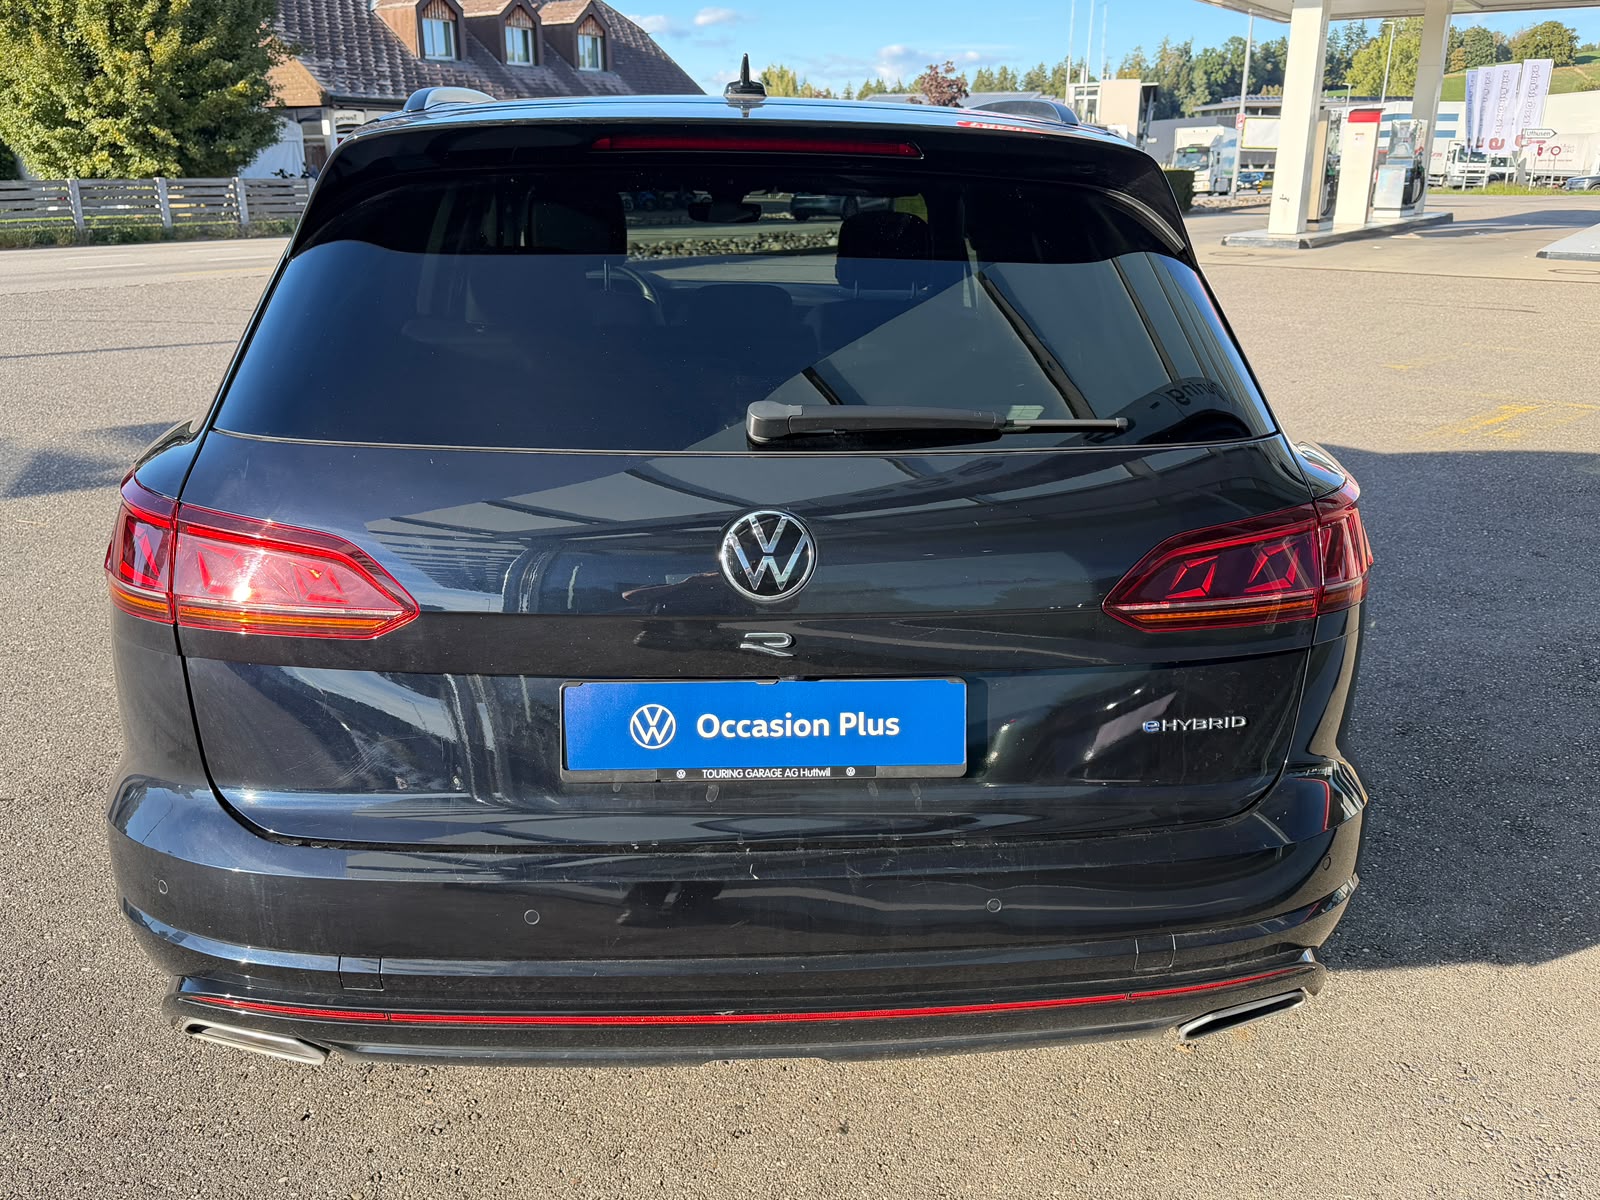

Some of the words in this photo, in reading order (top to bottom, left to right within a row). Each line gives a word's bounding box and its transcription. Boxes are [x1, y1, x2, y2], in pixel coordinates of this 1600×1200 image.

[739, 632, 794, 657] R
[696, 711, 830, 739] Occasion
[839, 711, 900, 736] Plus
[1142, 715, 1247, 733] eHYBRID
[702, 768, 743, 779] TOURING
[745, 768, 783, 779] GARAGE
[784, 768, 799, 778] AG
[800, 766, 831, 778] Huttwil
